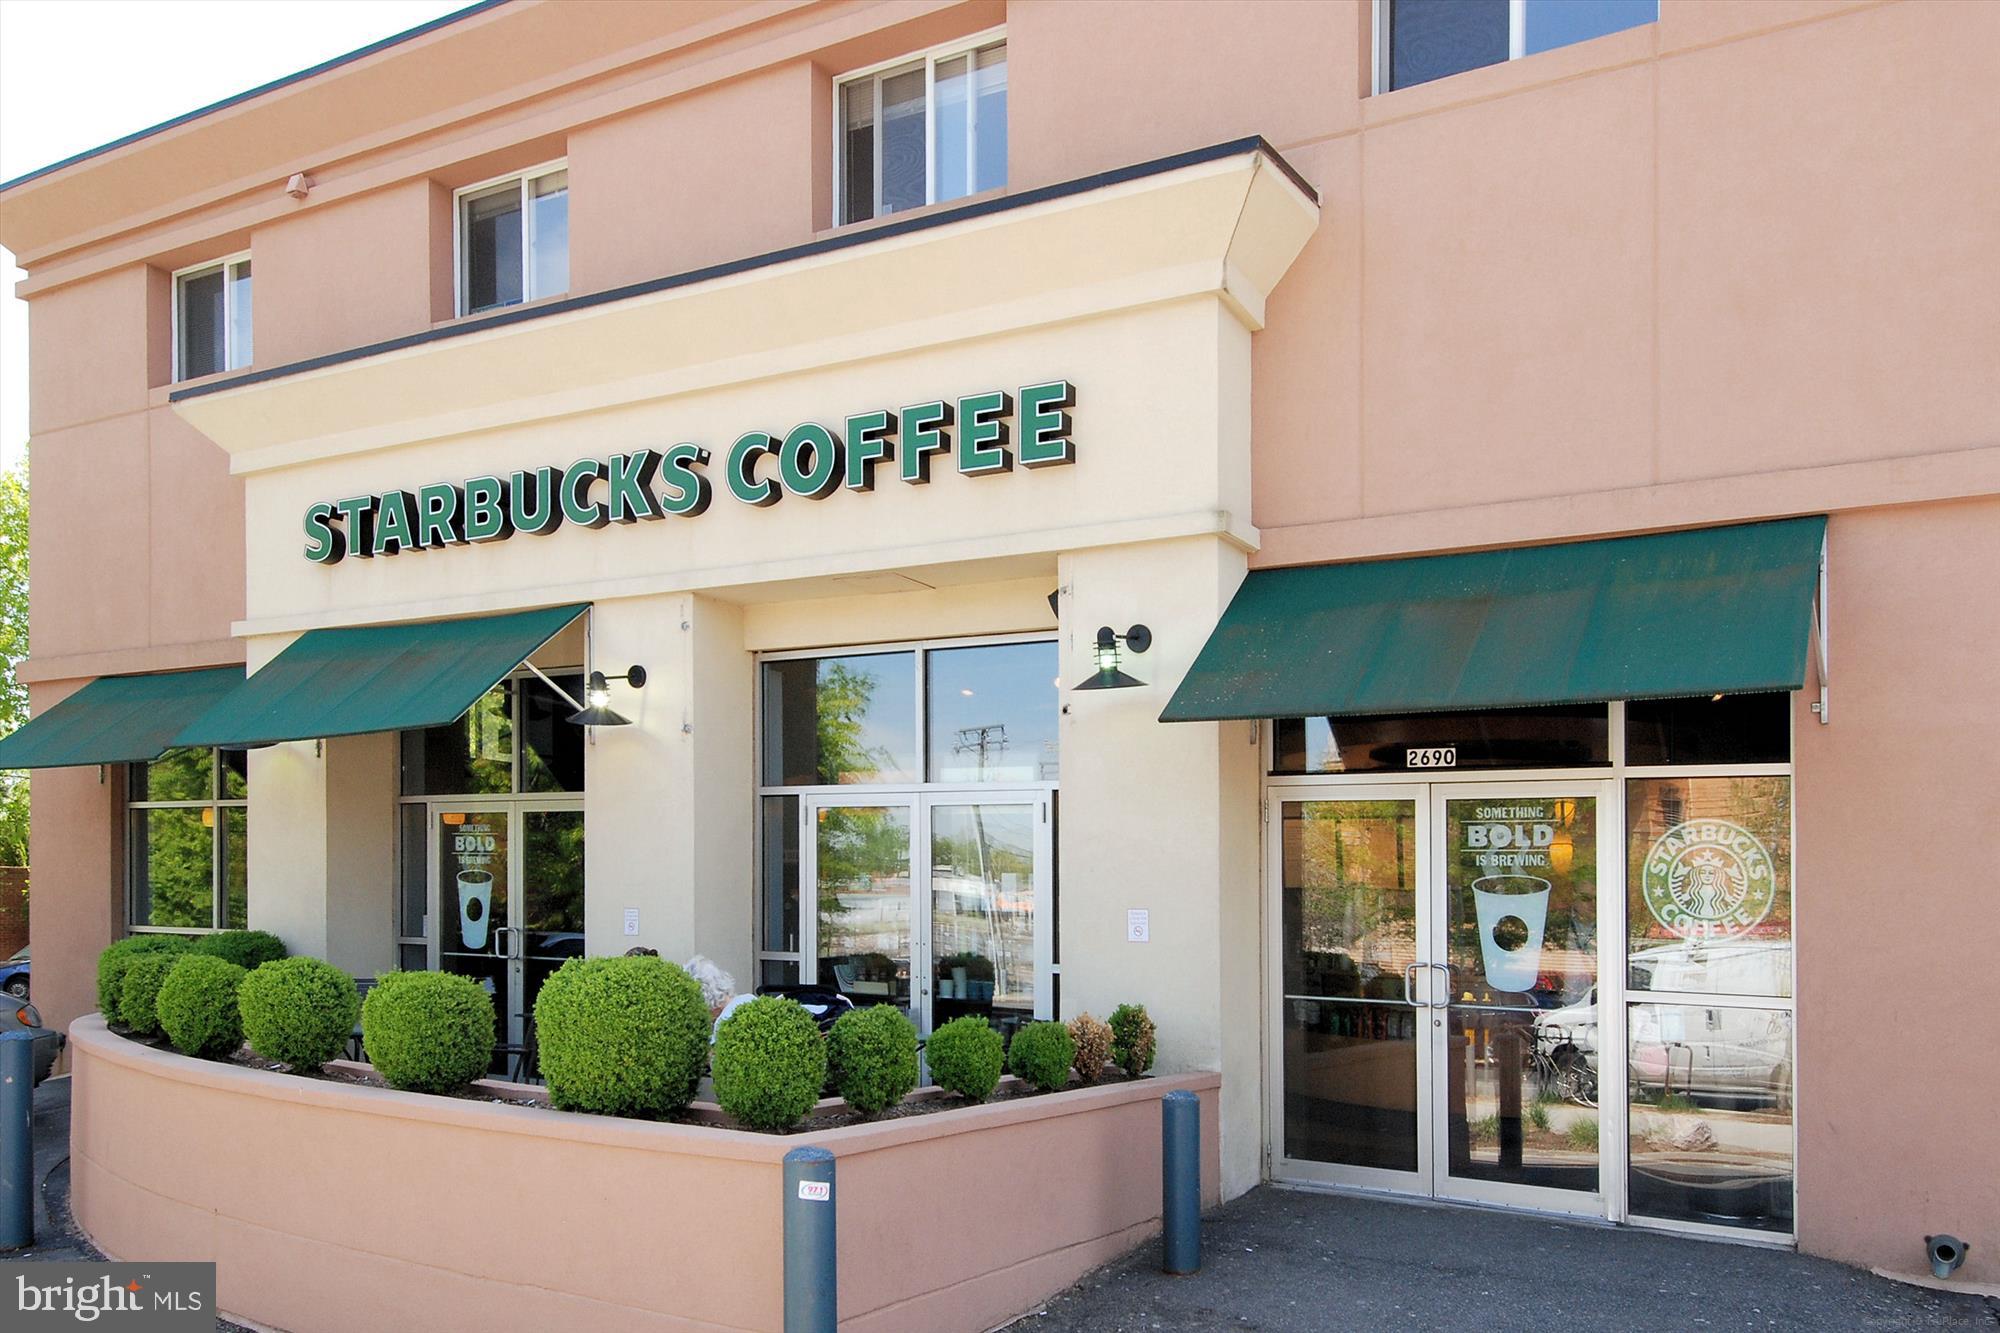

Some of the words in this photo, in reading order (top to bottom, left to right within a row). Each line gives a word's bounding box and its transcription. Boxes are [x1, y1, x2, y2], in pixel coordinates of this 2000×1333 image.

[303, 442, 712, 565] STARBUCKS
[725, 380, 1076, 508] COFFEE
[1409, 750, 1455, 766] 2690
[1475, 807, 1544, 819] SOMETHING
[1468, 824, 1553, 847] BOLD
[455, 836, 496, 852] BOLD
[1476, 855, 1486, 866] IS
[1491, 854, 1545, 866] BREWING
[1650, 825, 1767, 881] STARBUCKS
